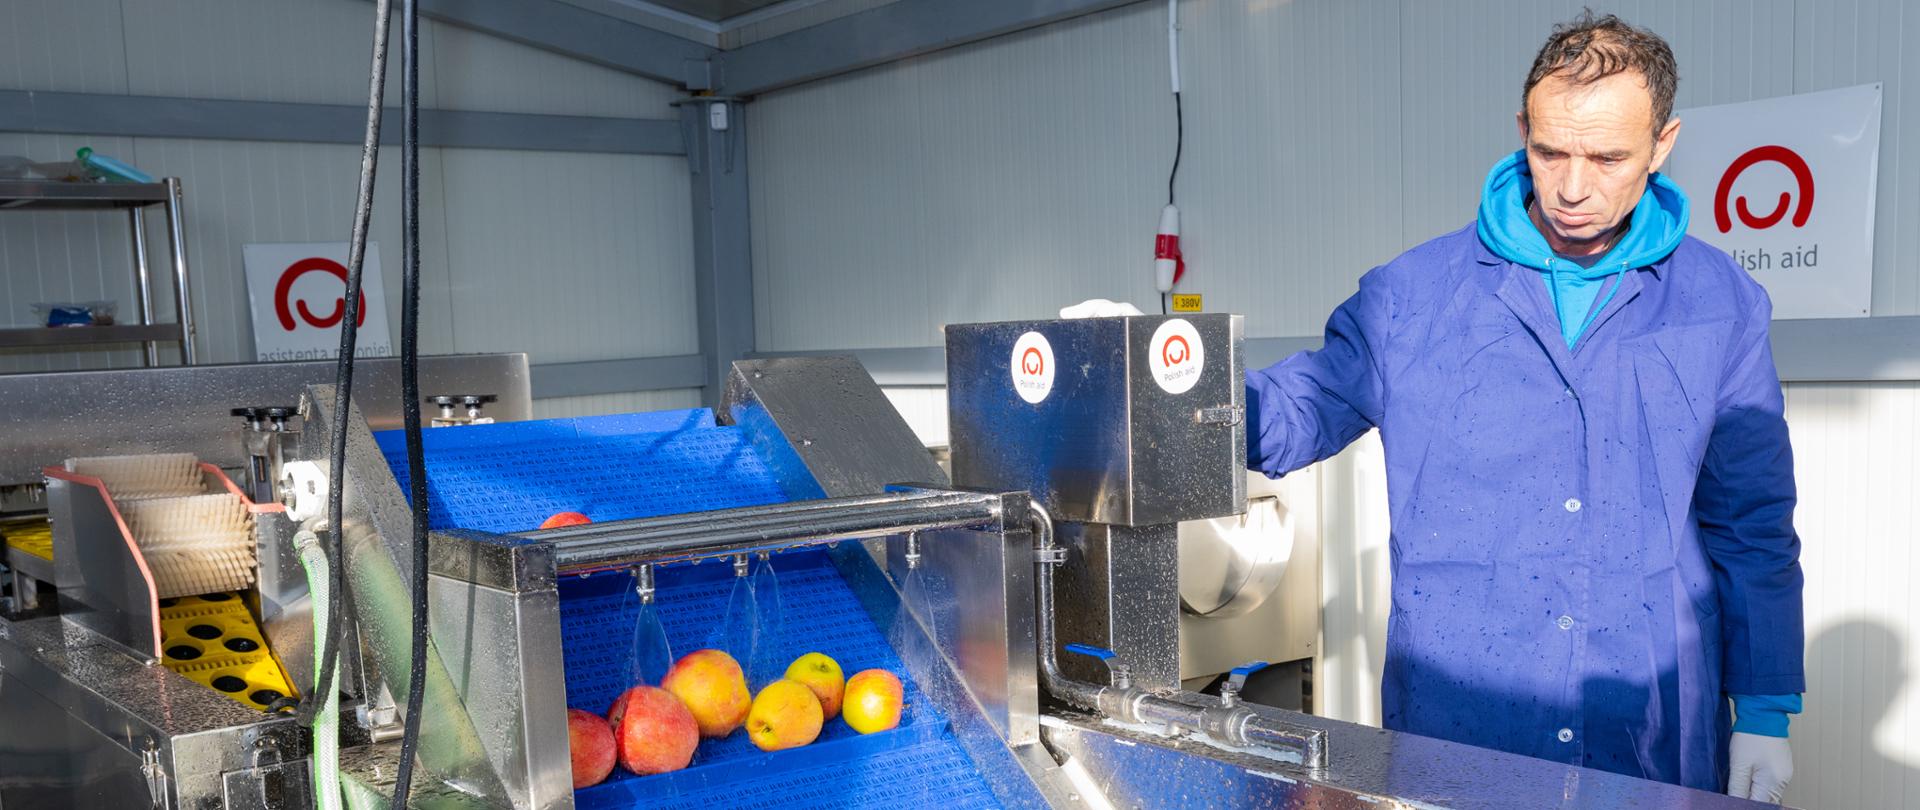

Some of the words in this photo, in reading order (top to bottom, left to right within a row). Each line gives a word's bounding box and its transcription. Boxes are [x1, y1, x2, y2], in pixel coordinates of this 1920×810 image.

[1732, 248, 1771, 271] lish
[1780, 244, 1818, 269] aid
[1181, 298, 1200, 308] 380V
[1164, 370, 1184, 381] Polish
[1185, 366, 1195, 376] aid
